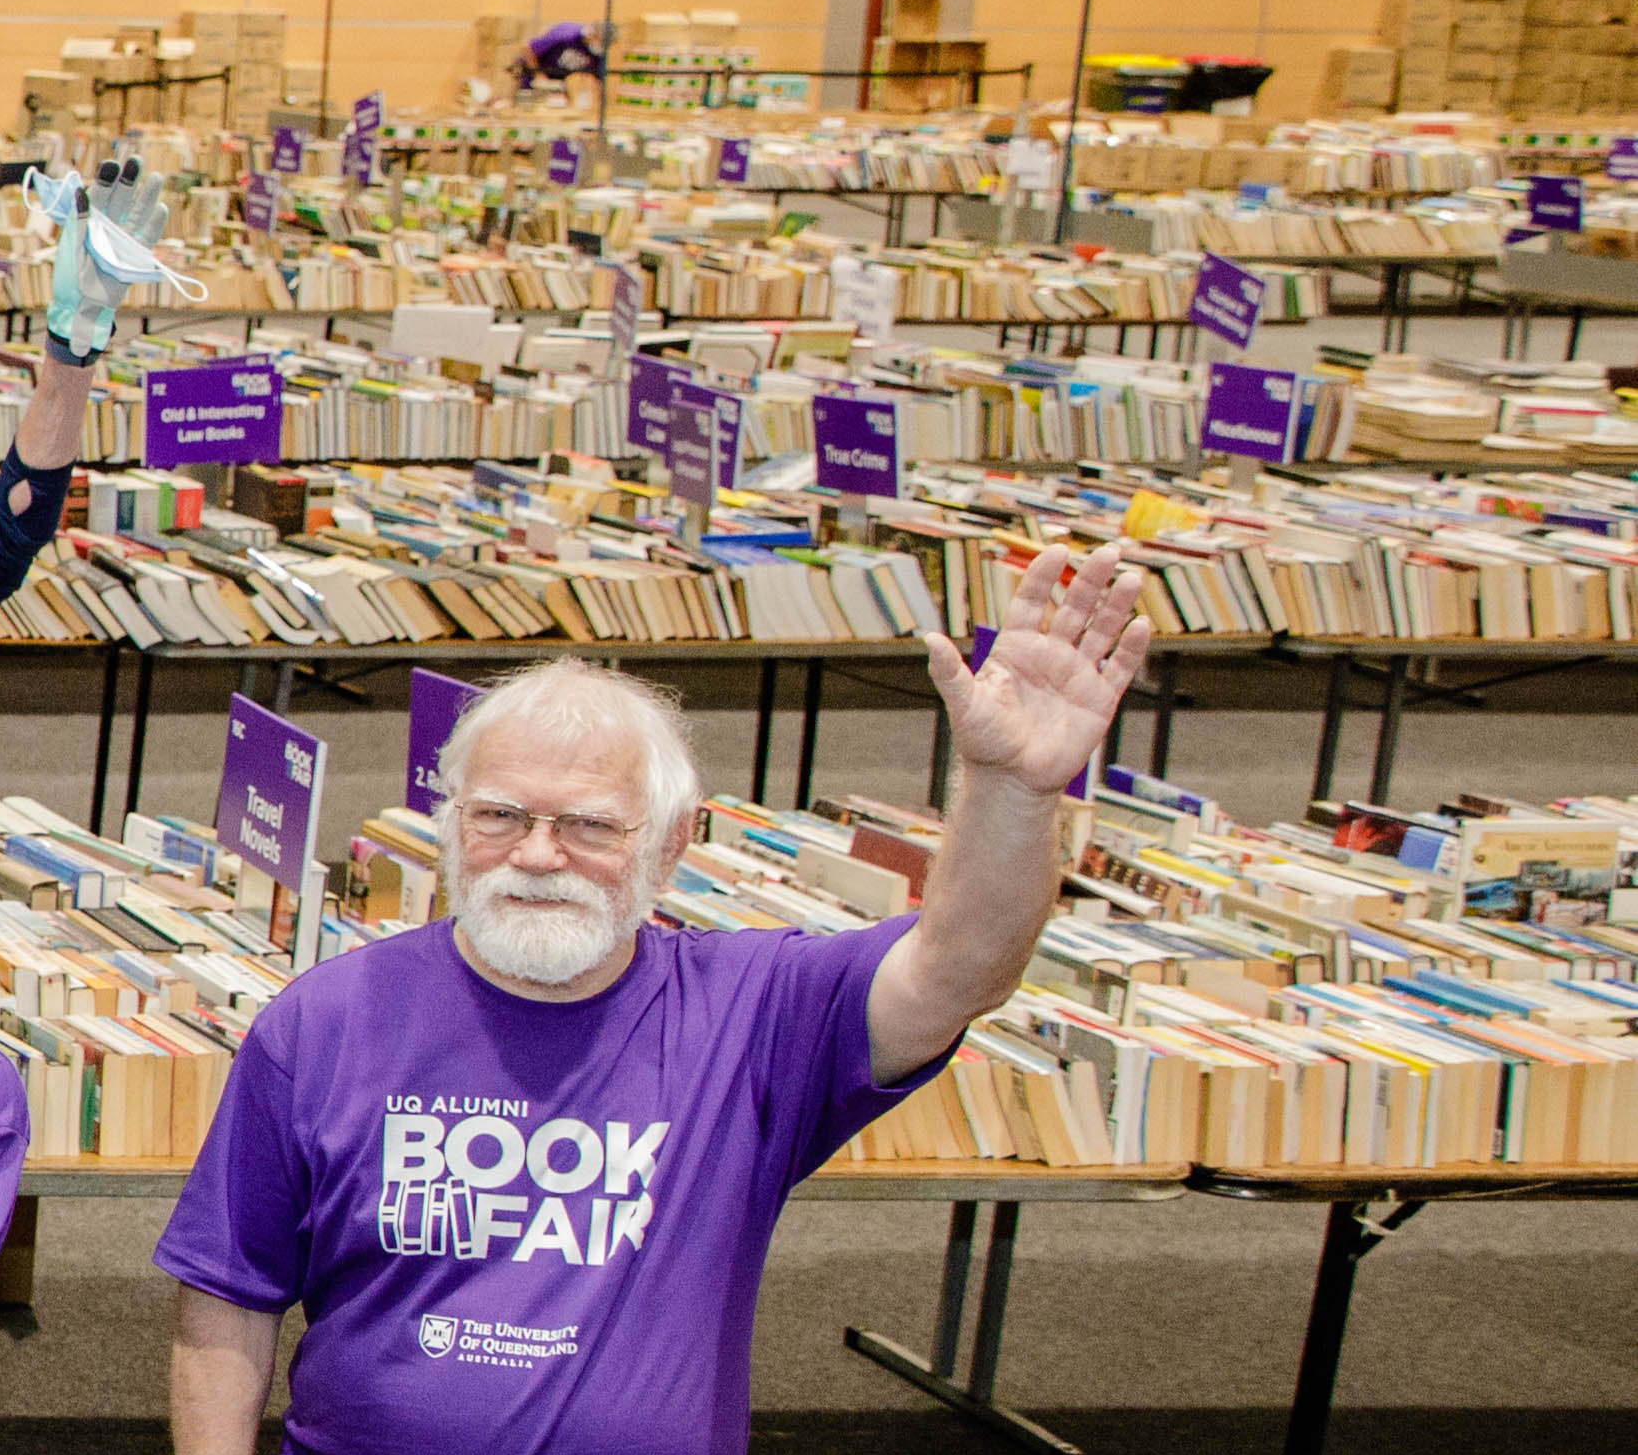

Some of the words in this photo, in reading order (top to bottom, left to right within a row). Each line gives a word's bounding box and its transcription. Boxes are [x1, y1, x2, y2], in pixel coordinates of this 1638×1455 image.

[160, 407, 186, 424] Old
[197, 403, 266, 422] Interesting
[177, 427, 205, 444] Law
[205, 425, 246, 442] Books
[824, 444, 851, 467] True
[850, 446, 889, 472] Crime
[284, 739, 314, 770] BOOK
[246, 785, 284, 832] Travel
[239, 818, 282, 865] Novels
[386, 1095, 423, 1114] UQ
[431, 1095, 529, 1118] ALUMNI
[383, 1113, 672, 1195] BOOK
[470, 1190, 654, 1266] FAIR
[462, 1319, 493, 1336] THE
[495, 1322, 579, 1342] UNIVERSITY
[458, 1334, 482, 1350] OF
[482, 1339, 579, 1359] QUEENSLAND
[457, 1352, 534, 1369] AUSTRALIA
